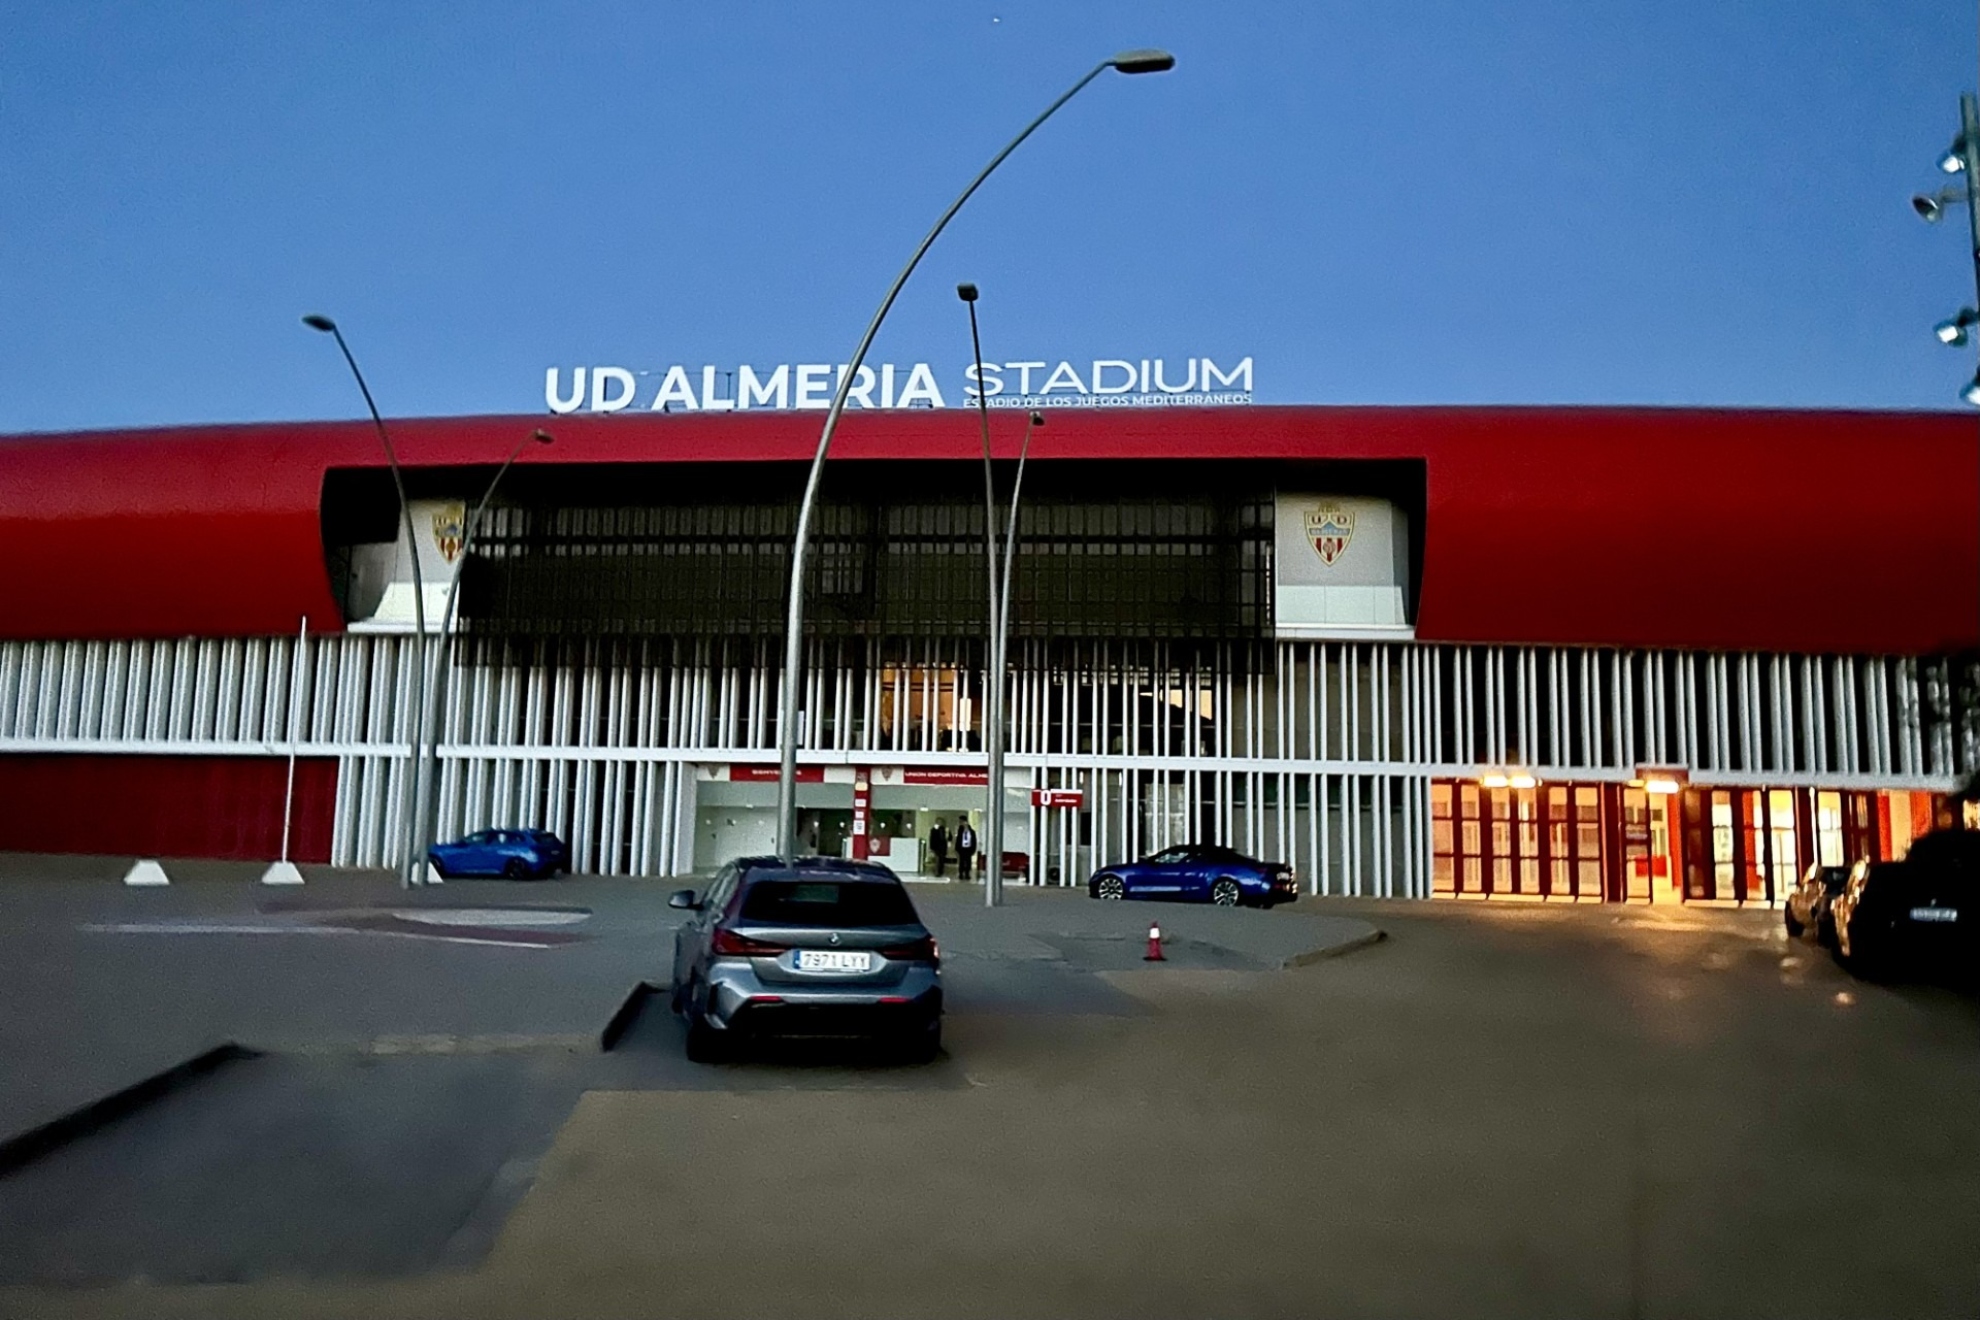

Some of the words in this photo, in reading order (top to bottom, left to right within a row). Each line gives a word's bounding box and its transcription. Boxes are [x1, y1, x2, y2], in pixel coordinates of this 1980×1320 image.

[545, 366, 636, 412] UD
[651, 363, 945, 410] ALMERIA
[963, 357, 1253, 396] STADIUM
[963, 398, 1019, 408] ESADIO
[1024, 397, 1043, 407] DE
[1046, 397, 1072, 406] LOS
[1075, 396, 1128, 406] JUEGOS
